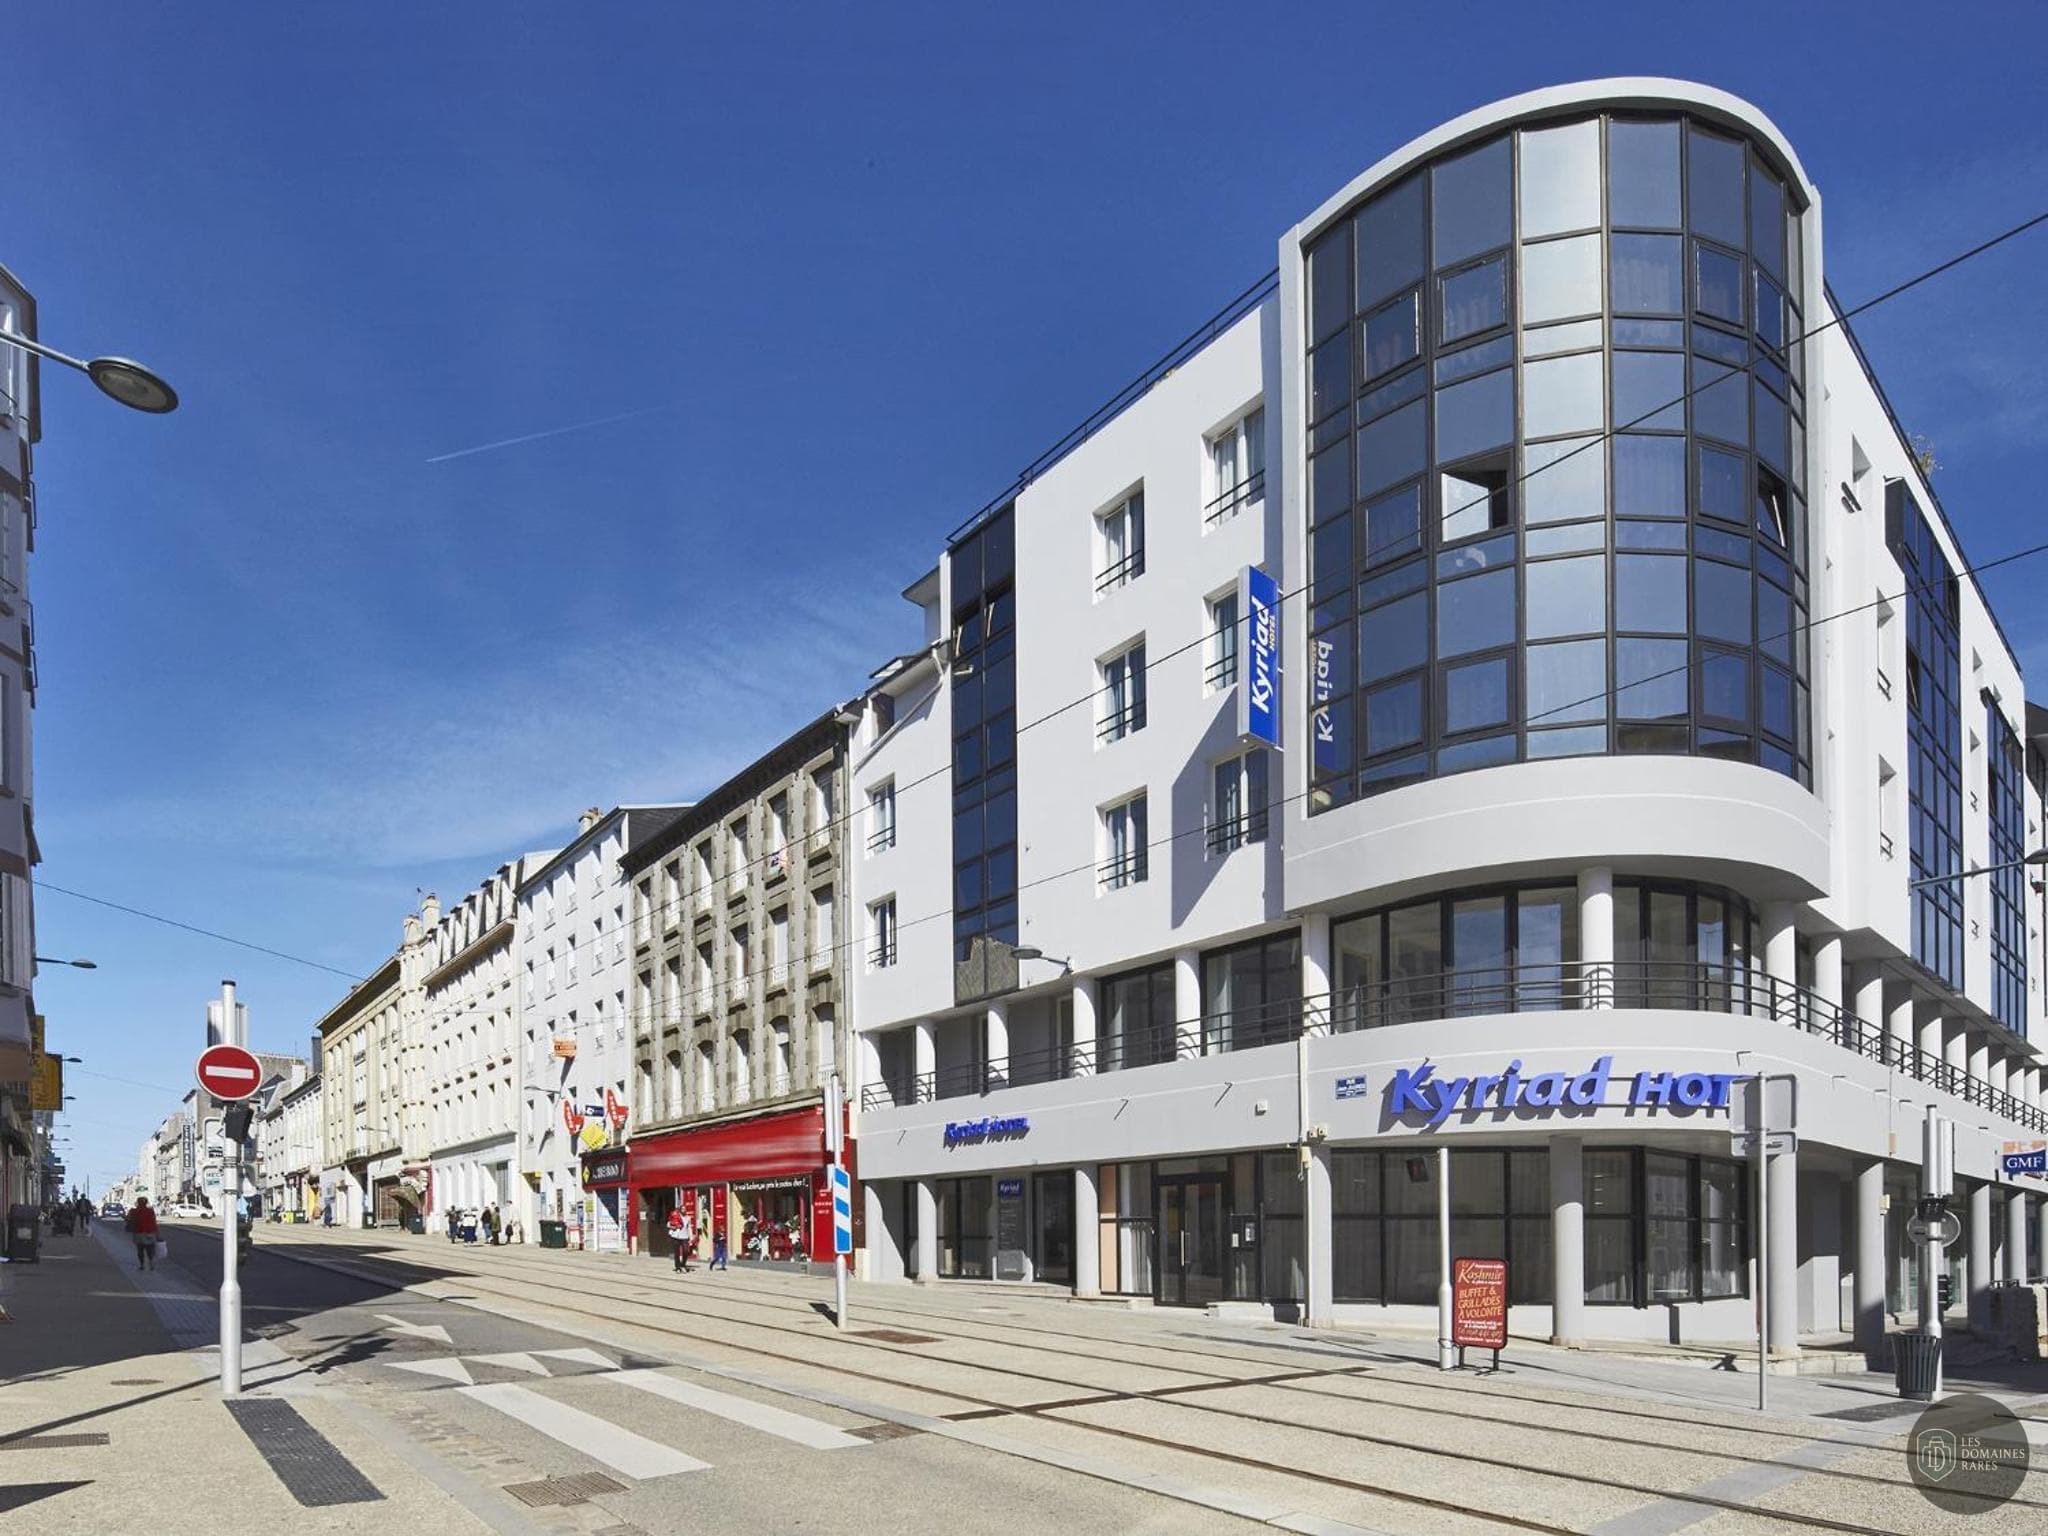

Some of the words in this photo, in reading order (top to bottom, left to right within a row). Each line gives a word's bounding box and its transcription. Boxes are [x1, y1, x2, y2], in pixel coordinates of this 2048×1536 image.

[1251, 595, 1273, 714] Kyriad
[1391, 1055, 1613, 1123] Kyriad
[1634, 1071, 1738, 1106] HOT
[945, 1117, 990, 1141] Kyriad
[2006, 1156, 2043, 1169] GMF
[1459, 1287, 1488, 1298] BUFFET
[1489, 1286, 1497, 1295] &
[1458, 1296, 1501, 1308] GRILLADES
